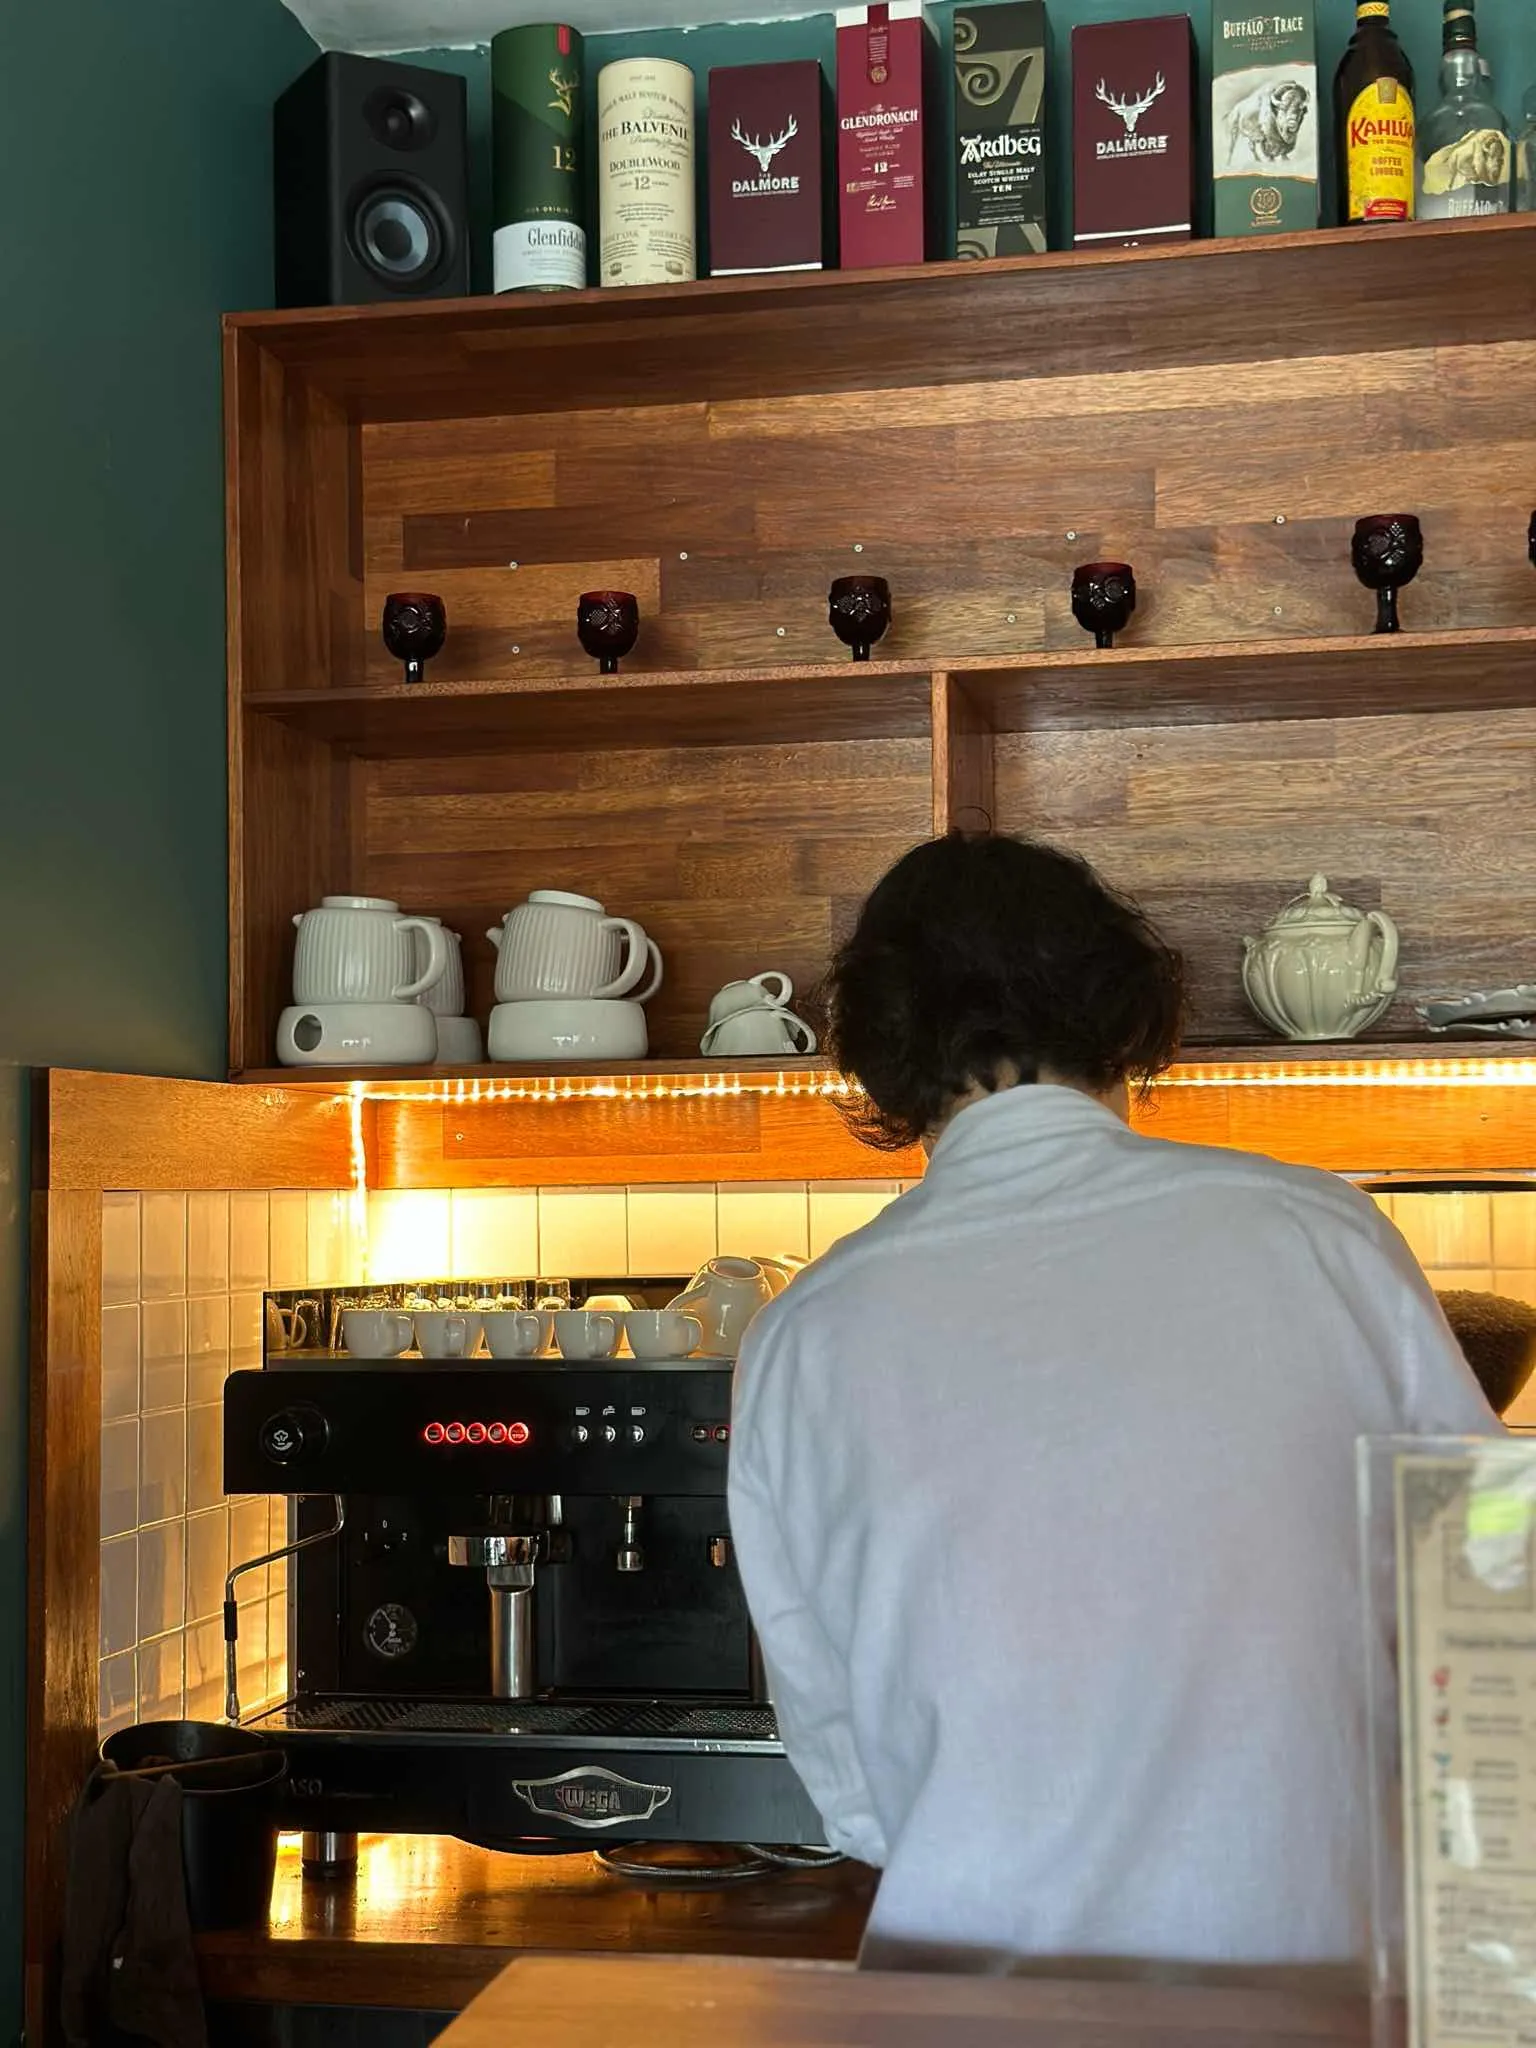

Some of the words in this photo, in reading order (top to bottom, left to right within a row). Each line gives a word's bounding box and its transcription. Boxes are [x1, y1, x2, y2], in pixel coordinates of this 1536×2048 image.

[1223, 20, 1264, 39] BUFFALO
[1272, 16, 1303, 35] TRACE
[841, 109, 918, 130] GLENDRONACH
[1096, 136, 1169, 154] DALMORE
[552, 145, 577, 172] 12
[973, 177, 1000, 185] SCOTCH
[988, 168, 1014, 177] SINGLE
[634, 176, 651, 190] 12
[732, 176, 800, 193] DALMORE
[992, 184, 1013, 193] TEN
[382, 1520, 388, 1528] 0
[562, 1785, 621, 1811] WEGA
